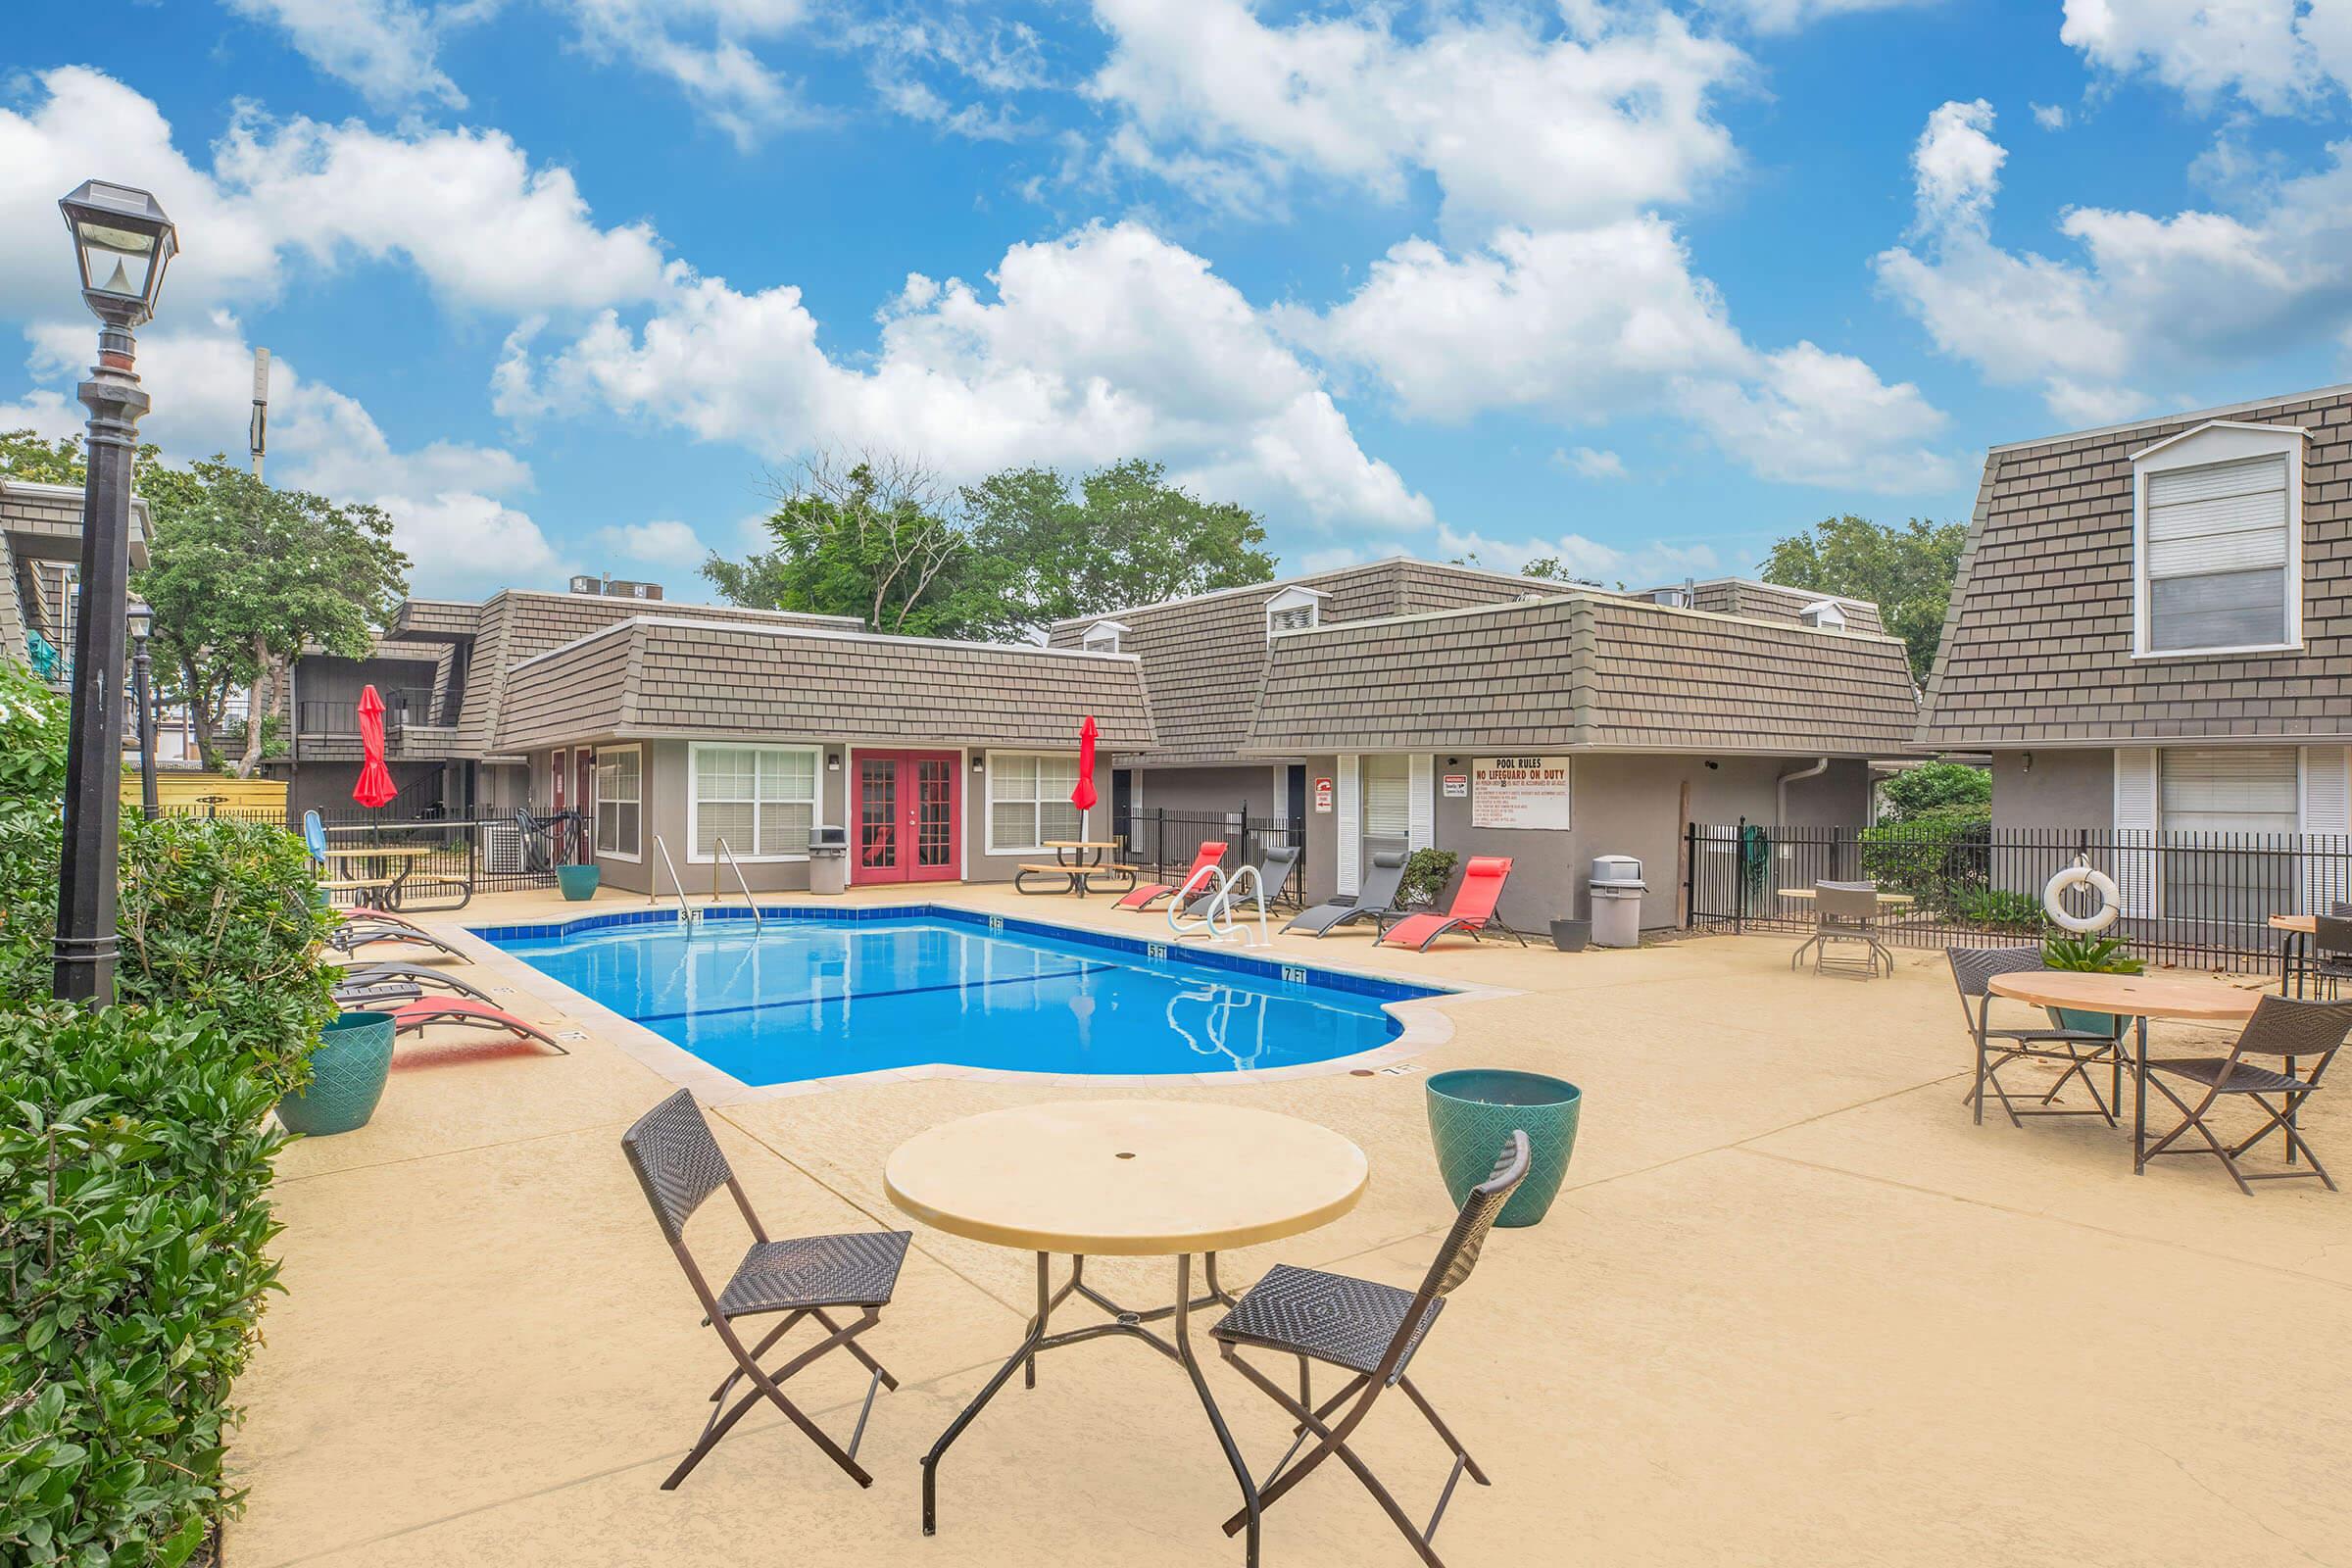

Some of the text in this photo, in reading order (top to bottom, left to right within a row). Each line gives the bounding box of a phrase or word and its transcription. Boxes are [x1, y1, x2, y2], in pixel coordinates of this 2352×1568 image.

[1496, 758, 1542, 768] POOL RULES
[1476, 770, 1487, 780] NO
[1489, 769, 1527, 780] LIFEGUARD
[1530, 769, 1541, 780] ON
[1544, 768, 1565, 780] DUTY
[681, 909, 703, 922] 3 FT
[1150, 945, 1166, 958] 5 FT
[1285, 967, 1305, 984] 7 FT
